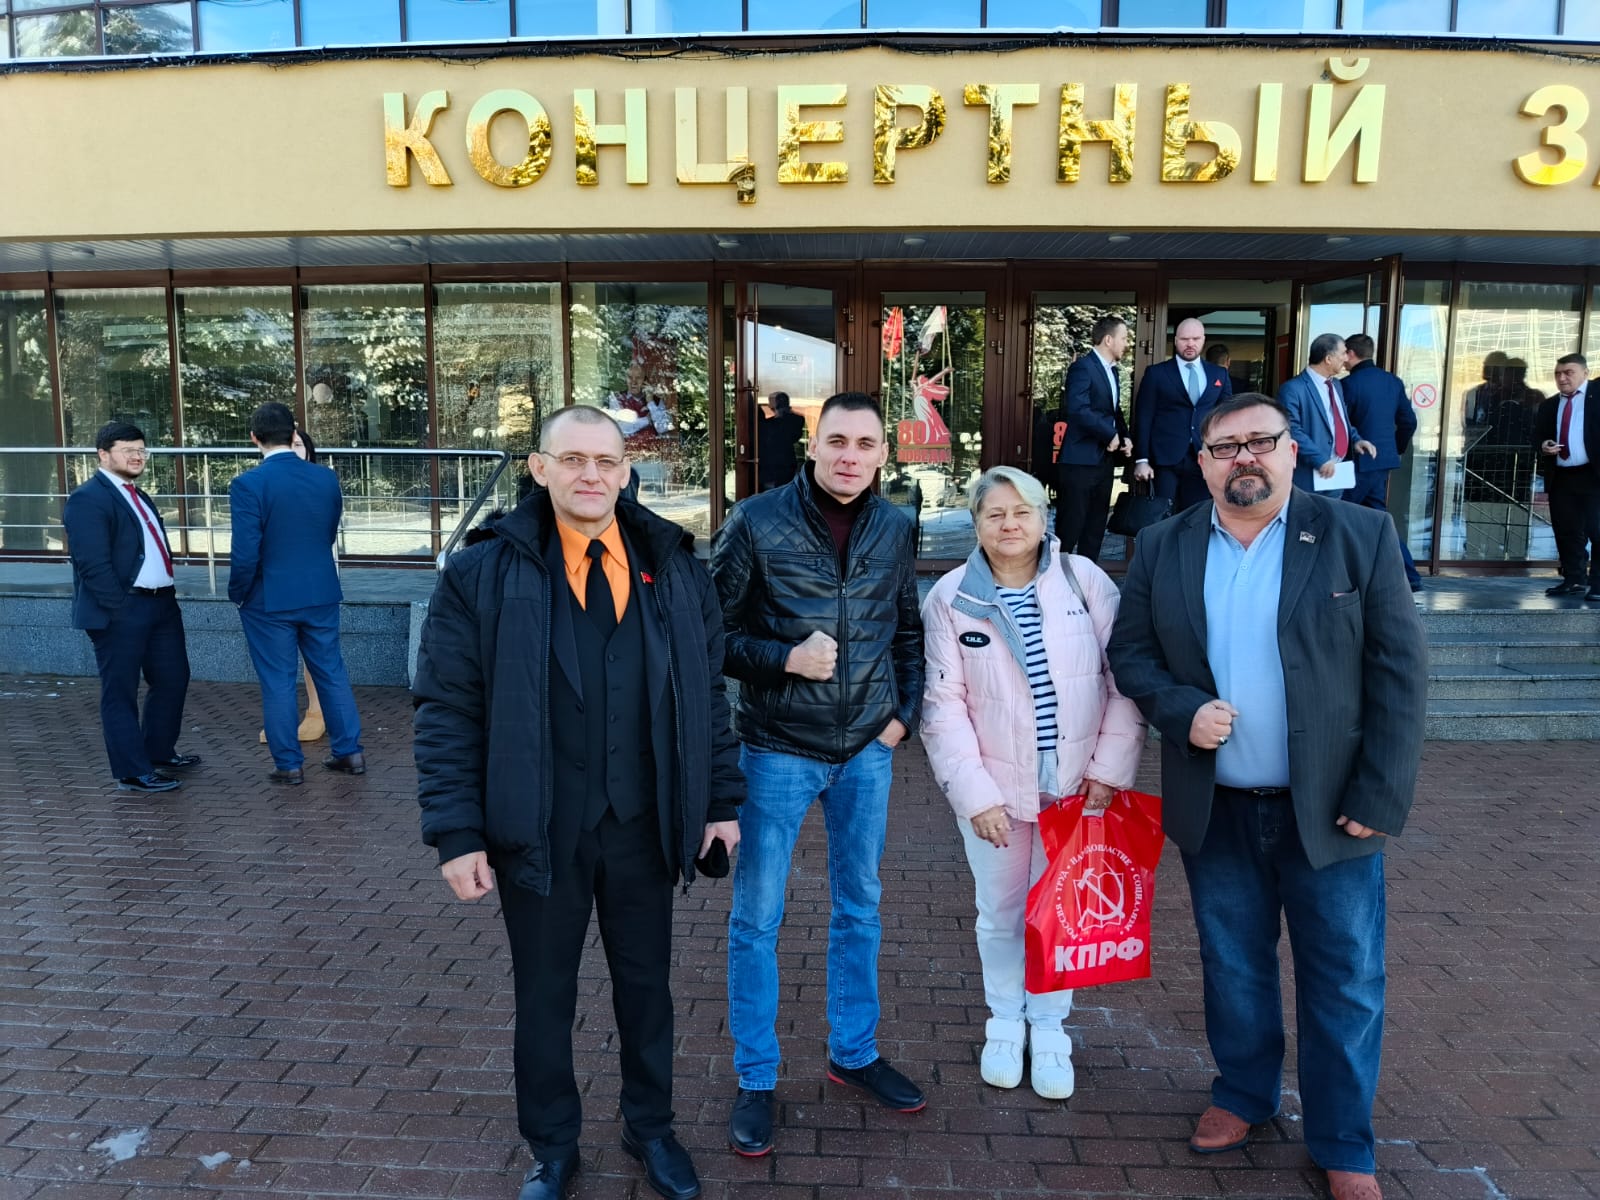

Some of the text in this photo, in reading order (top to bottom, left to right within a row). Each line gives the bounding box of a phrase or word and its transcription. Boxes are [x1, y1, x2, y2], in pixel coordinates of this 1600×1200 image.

[383, 57, 1600, 204] КОНЦЕРТНЫЙ З
[897, 420, 927, 445] 80
[1053, 421, 1068, 447] 8
[1055, 843, 1143, 940] РОССИЯ ТРУД НАРДОВЛАСТИЕ СОЦИАЛИЗМ
[1055, 936, 1144, 972] КПРФ
